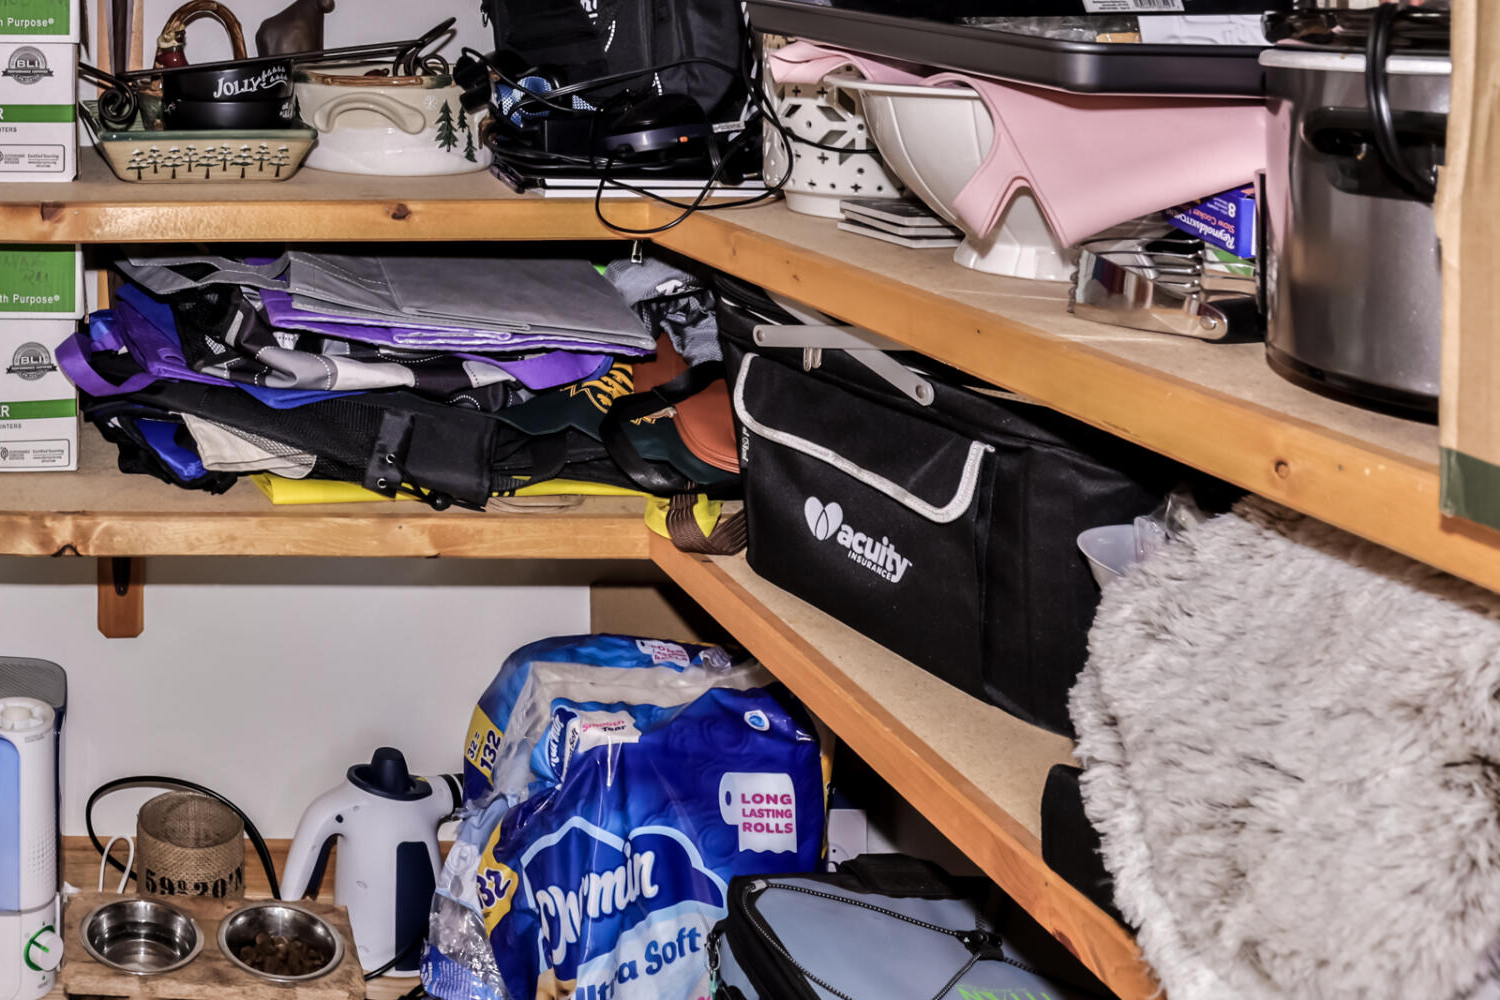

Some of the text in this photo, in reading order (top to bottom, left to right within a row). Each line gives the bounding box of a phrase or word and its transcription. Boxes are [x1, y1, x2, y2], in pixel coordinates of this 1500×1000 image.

[1227, 202, 1237, 218] 8
[1218, 219, 1235, 234] Slow
[837, 523, 908, 584] acuity
[848, 550, 893, 581] INSURANCE
[581, 718, 626, 733] Smooth
[601, 724, 627, 732] Tear
[479, 729, 501, 772] 132
[740, 793, 792, 806] LONG
[741, 808, 793, 819] LASTING
[742, 822, 794, 834] ROLLS
[643, 926, 703, 977] Soft
